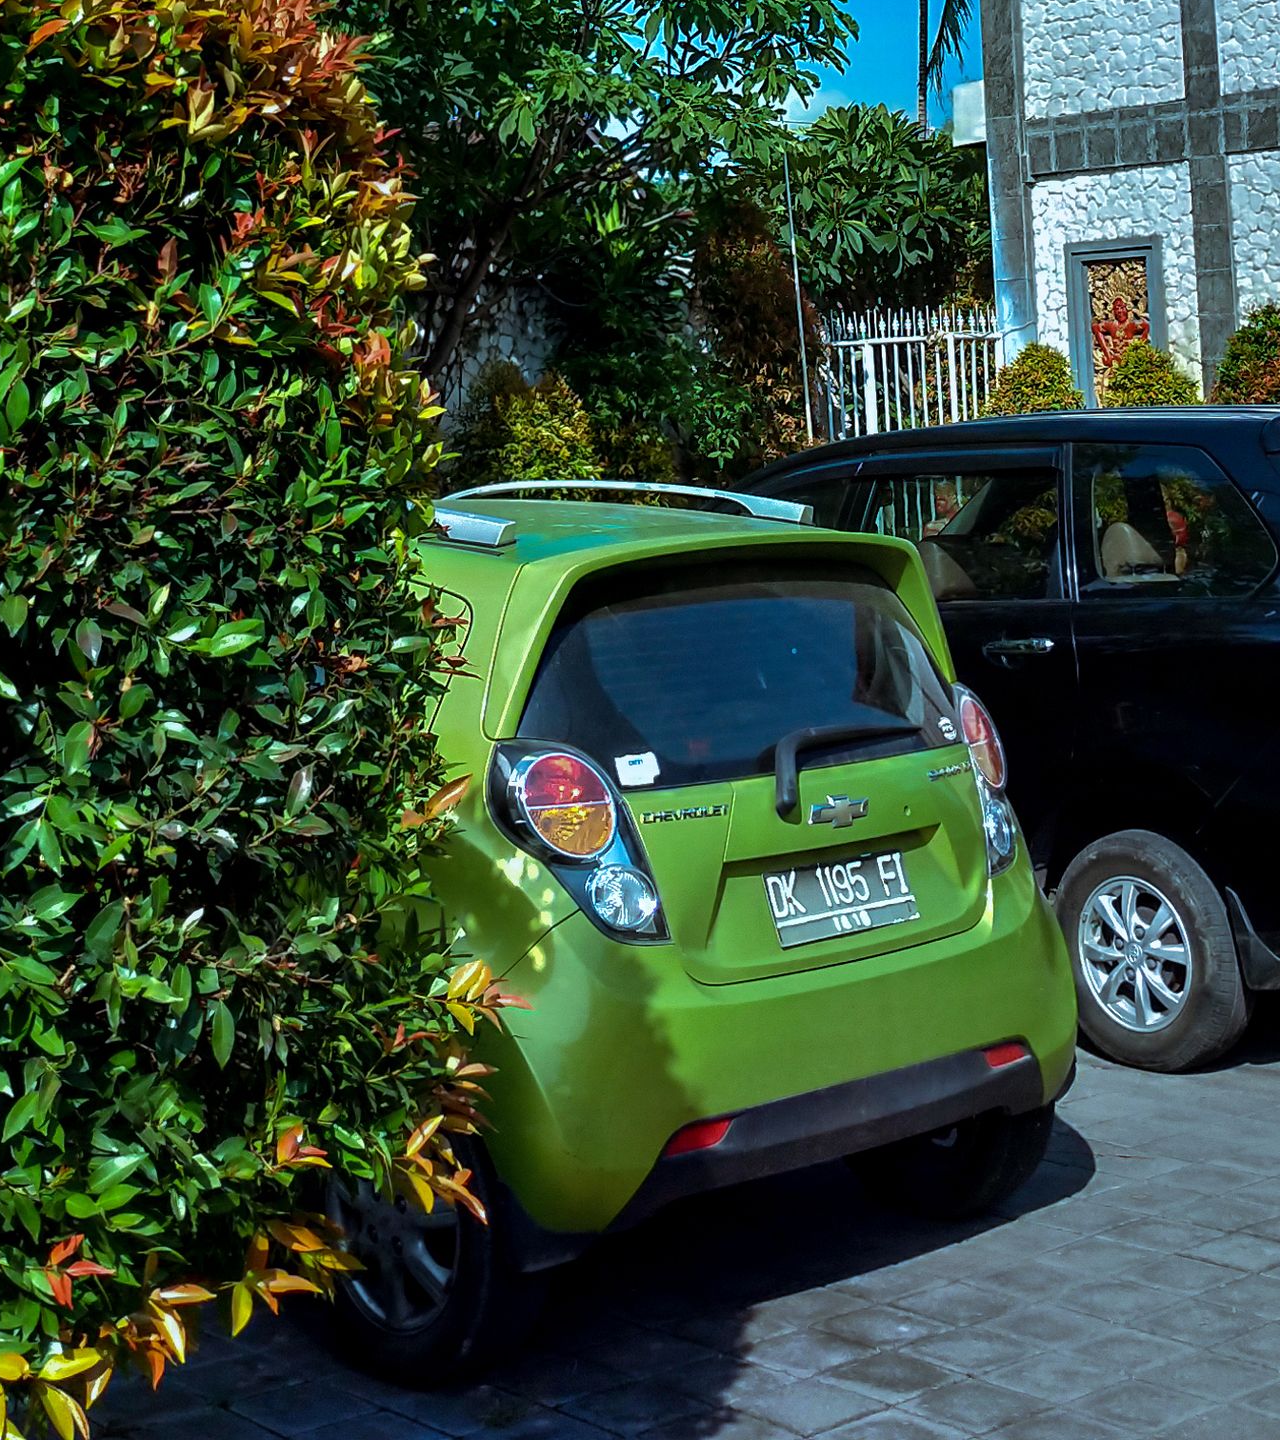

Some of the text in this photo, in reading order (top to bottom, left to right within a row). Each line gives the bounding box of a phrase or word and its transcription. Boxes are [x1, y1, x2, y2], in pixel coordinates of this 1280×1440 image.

[641, 803, 729, 824] CHEVROLET
[766, 851, 910, 918] DK 1195 FI
